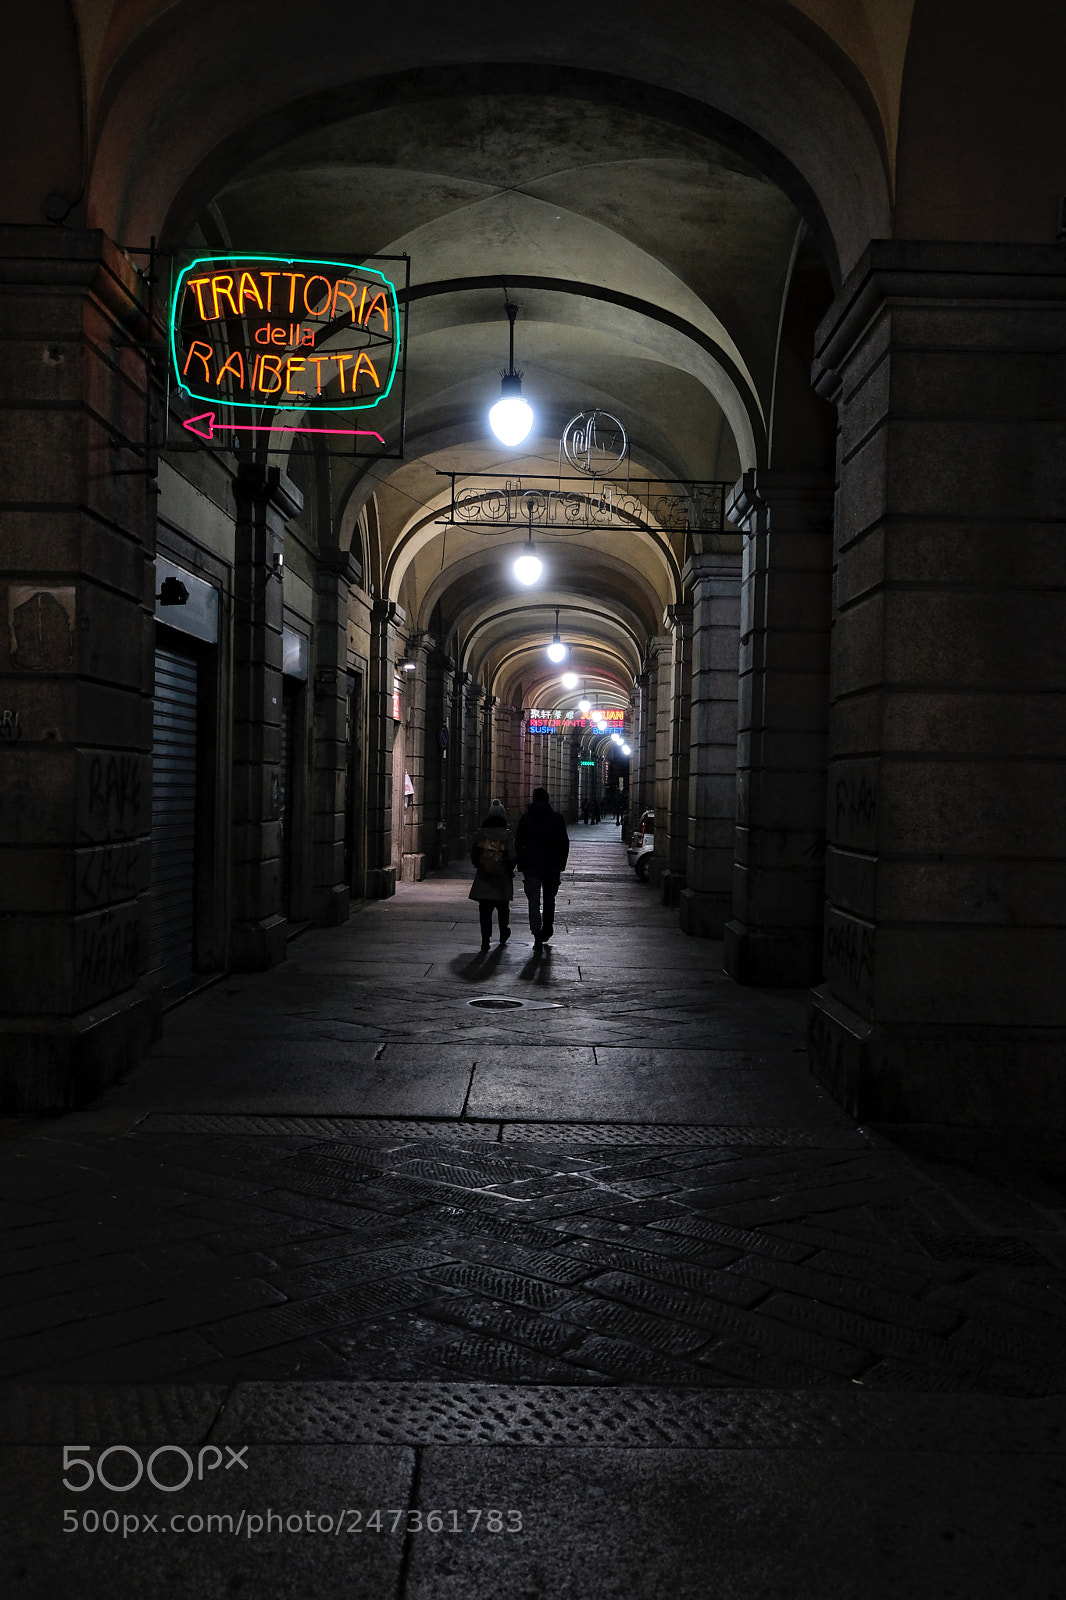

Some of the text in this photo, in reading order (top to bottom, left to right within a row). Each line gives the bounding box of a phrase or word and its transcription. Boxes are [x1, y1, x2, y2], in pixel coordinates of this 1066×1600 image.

[187, 272, 389, 332] TRATTORIA
[254, 322, 315, 347] della
[183, 340, 380, 395] RAIBETTA
[529, 726, 556, 734] SUSHI
[530, 719, 586, 728] RISTORANTE
